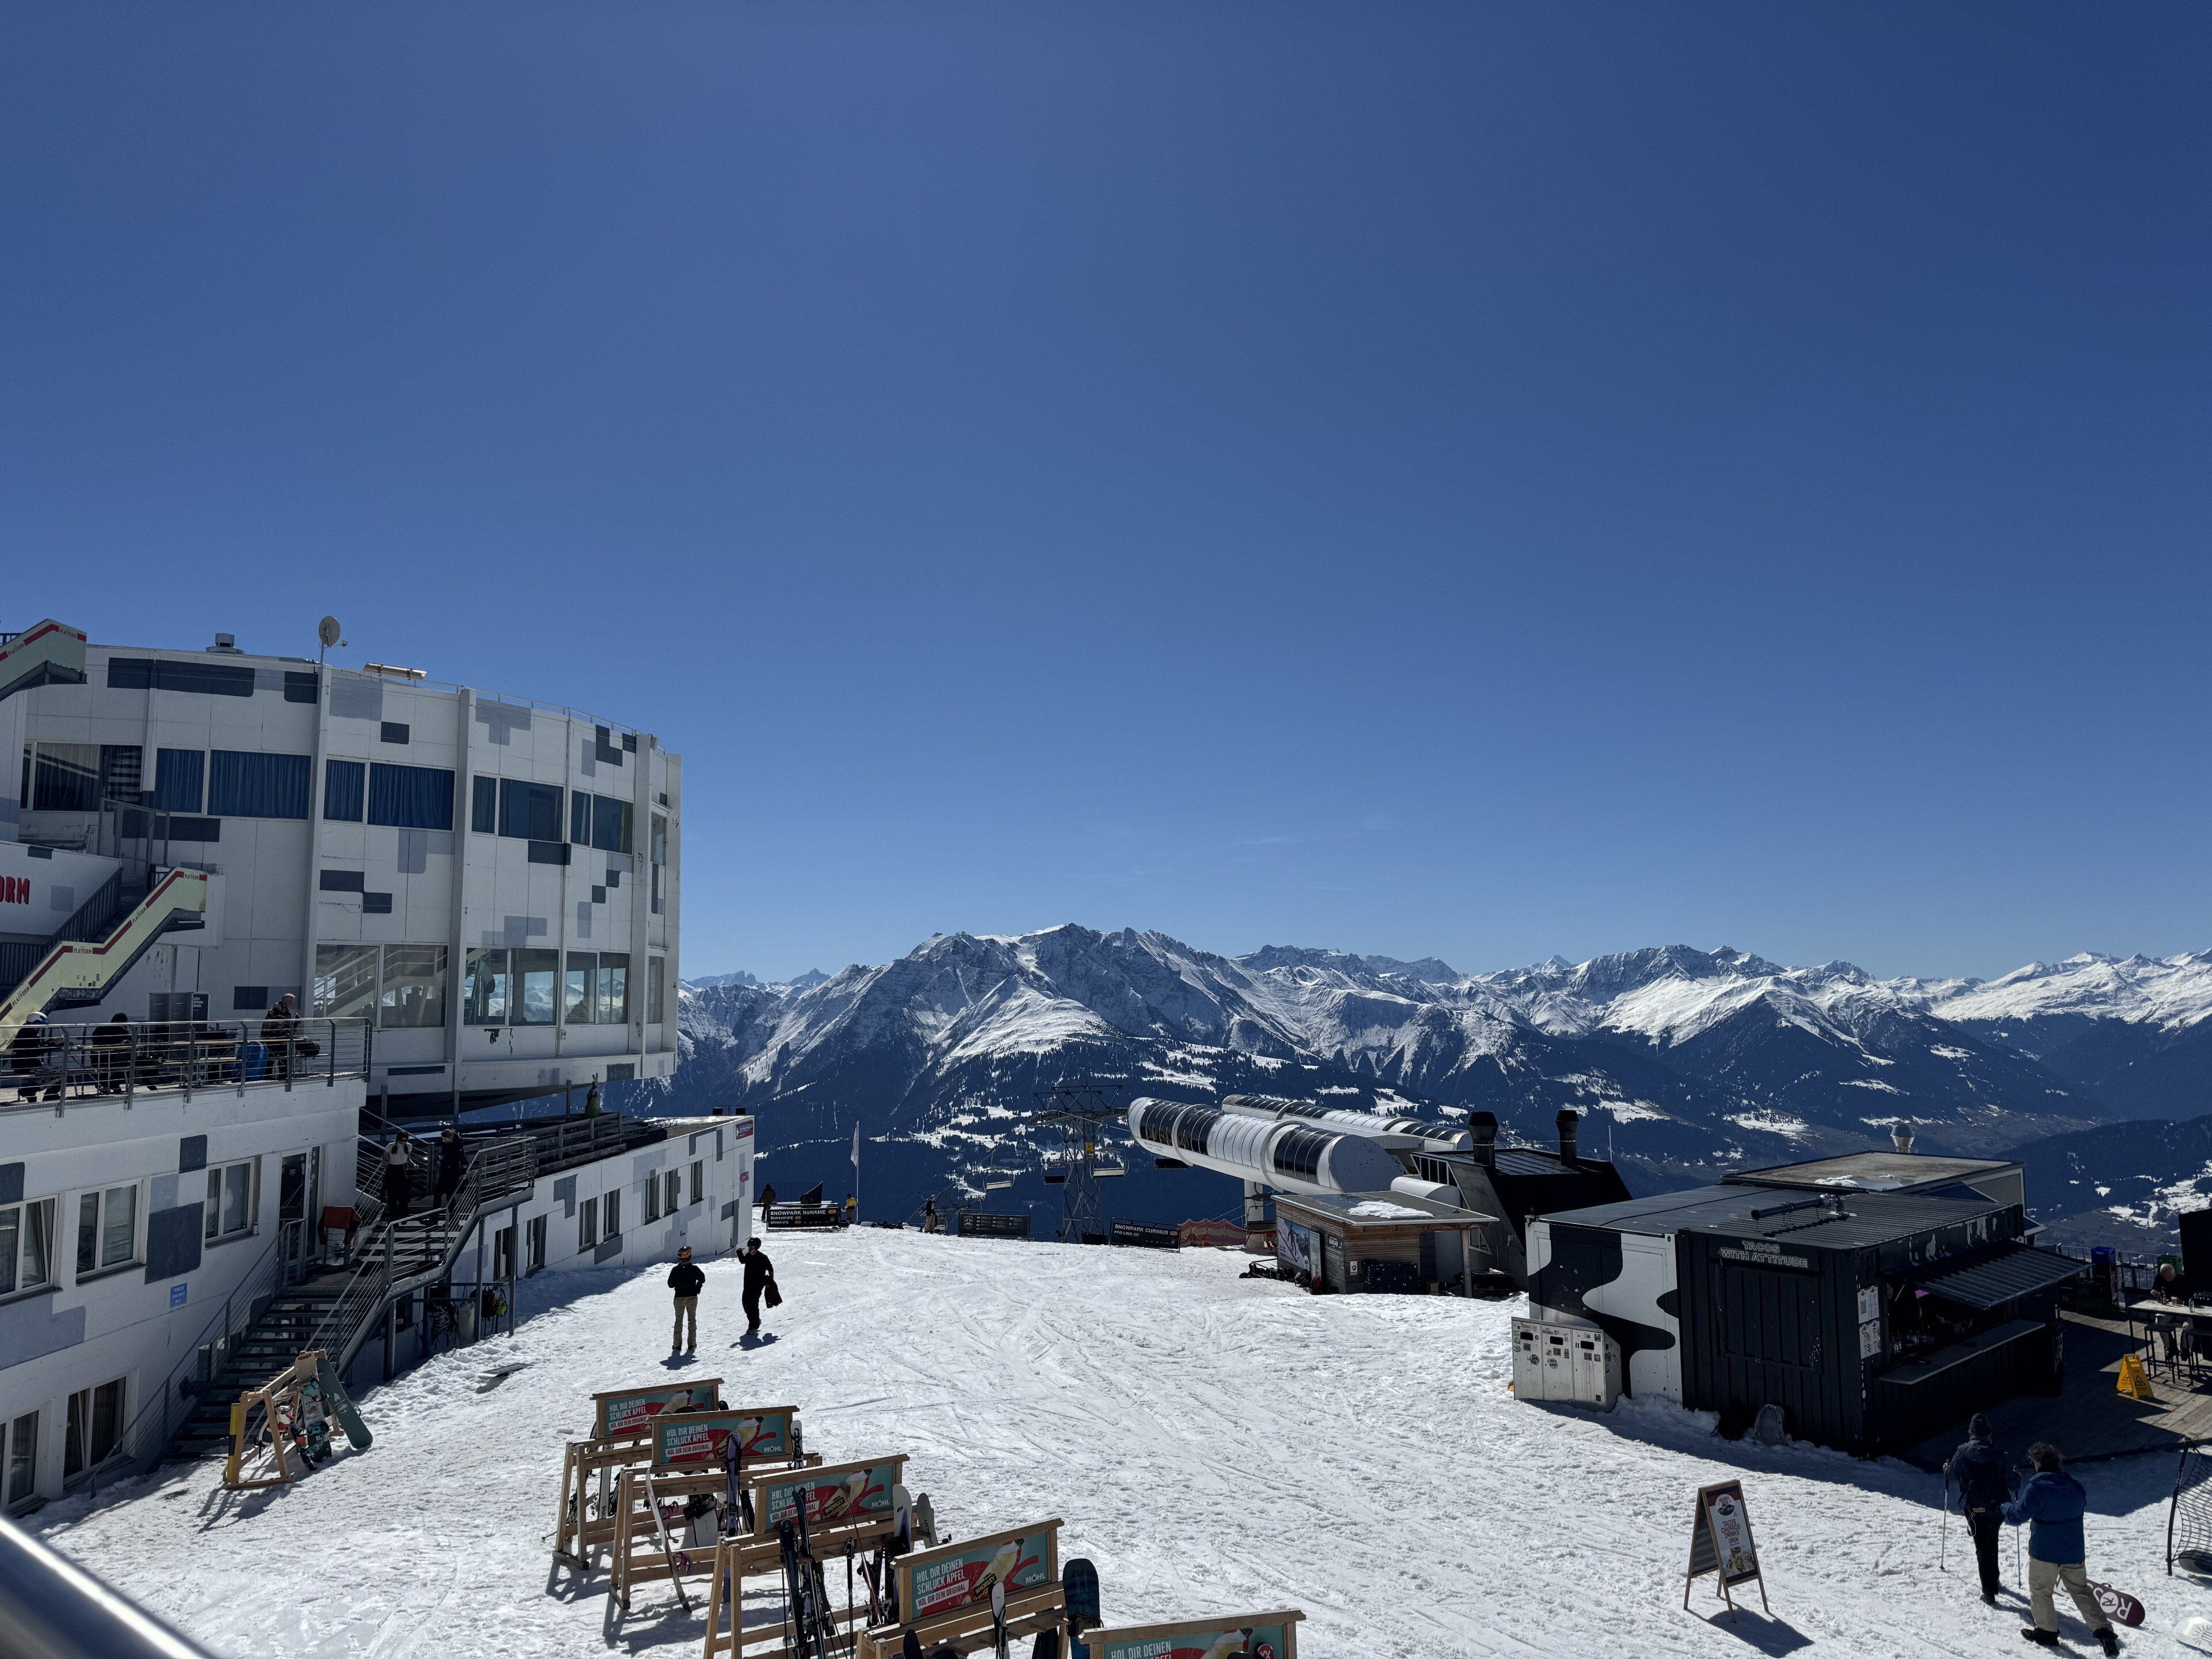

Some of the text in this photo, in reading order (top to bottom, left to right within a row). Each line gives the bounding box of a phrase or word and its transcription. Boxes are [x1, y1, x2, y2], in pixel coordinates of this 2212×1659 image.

[59, 628, 76, 638] PLATFORM
[7, 643, 24, 656] PLATFORM
[132, 907, 146, 923] PLATFORM
[12, 986, 30, 1007] PLATFORM
[1115, 1224, 1144, 1232] SNOWPARK
[1742, 1241, 1780, 1253] TACOS
[1721, 1248, 1808, 1268] WITH ATTITUDE
[609, 1399, 645, 1412] HOL DIR DEINEN
[610, 1406, 647, 1421] SCHLUCK APFEL
[666, 1424, 708, 1438] HOL DIR DEINEN
[667, 1433, 709, 1446] SCHLUCK APFEL
[692, 1444, 710, 1452] ORIGINAL
[772, 1490, 783, 1501] HOL
[785, 1487, 793, 1497] DIR
[825, 1498, 843, 1514] SHORLEY
[1721, 1524, 1740, 1533] CHURROS
[1722, 1518, 1737, 1527] TACOS
[1725, 1530, 1740, 1539] DRINKS
[917, 1558, 963, 1584] HOL DIR DEINEN
[918, 1575, 945, 1594] SCHLUCK
[946, 1569, 965, 1584] APFEL
[975, 1574, 995, 1594] SHORLEY
[918, 1597, 927, 1607] HOL
[935, 1590, 945, 1600] DEIN
[946, 1584, 965, 1596] ORIGINAL
[1111, 1649, 1127, 1659] HOL
[1128, 1646, 1142, 1659] DIR
[1143, 1641, 1172, 1657] DEINEN
